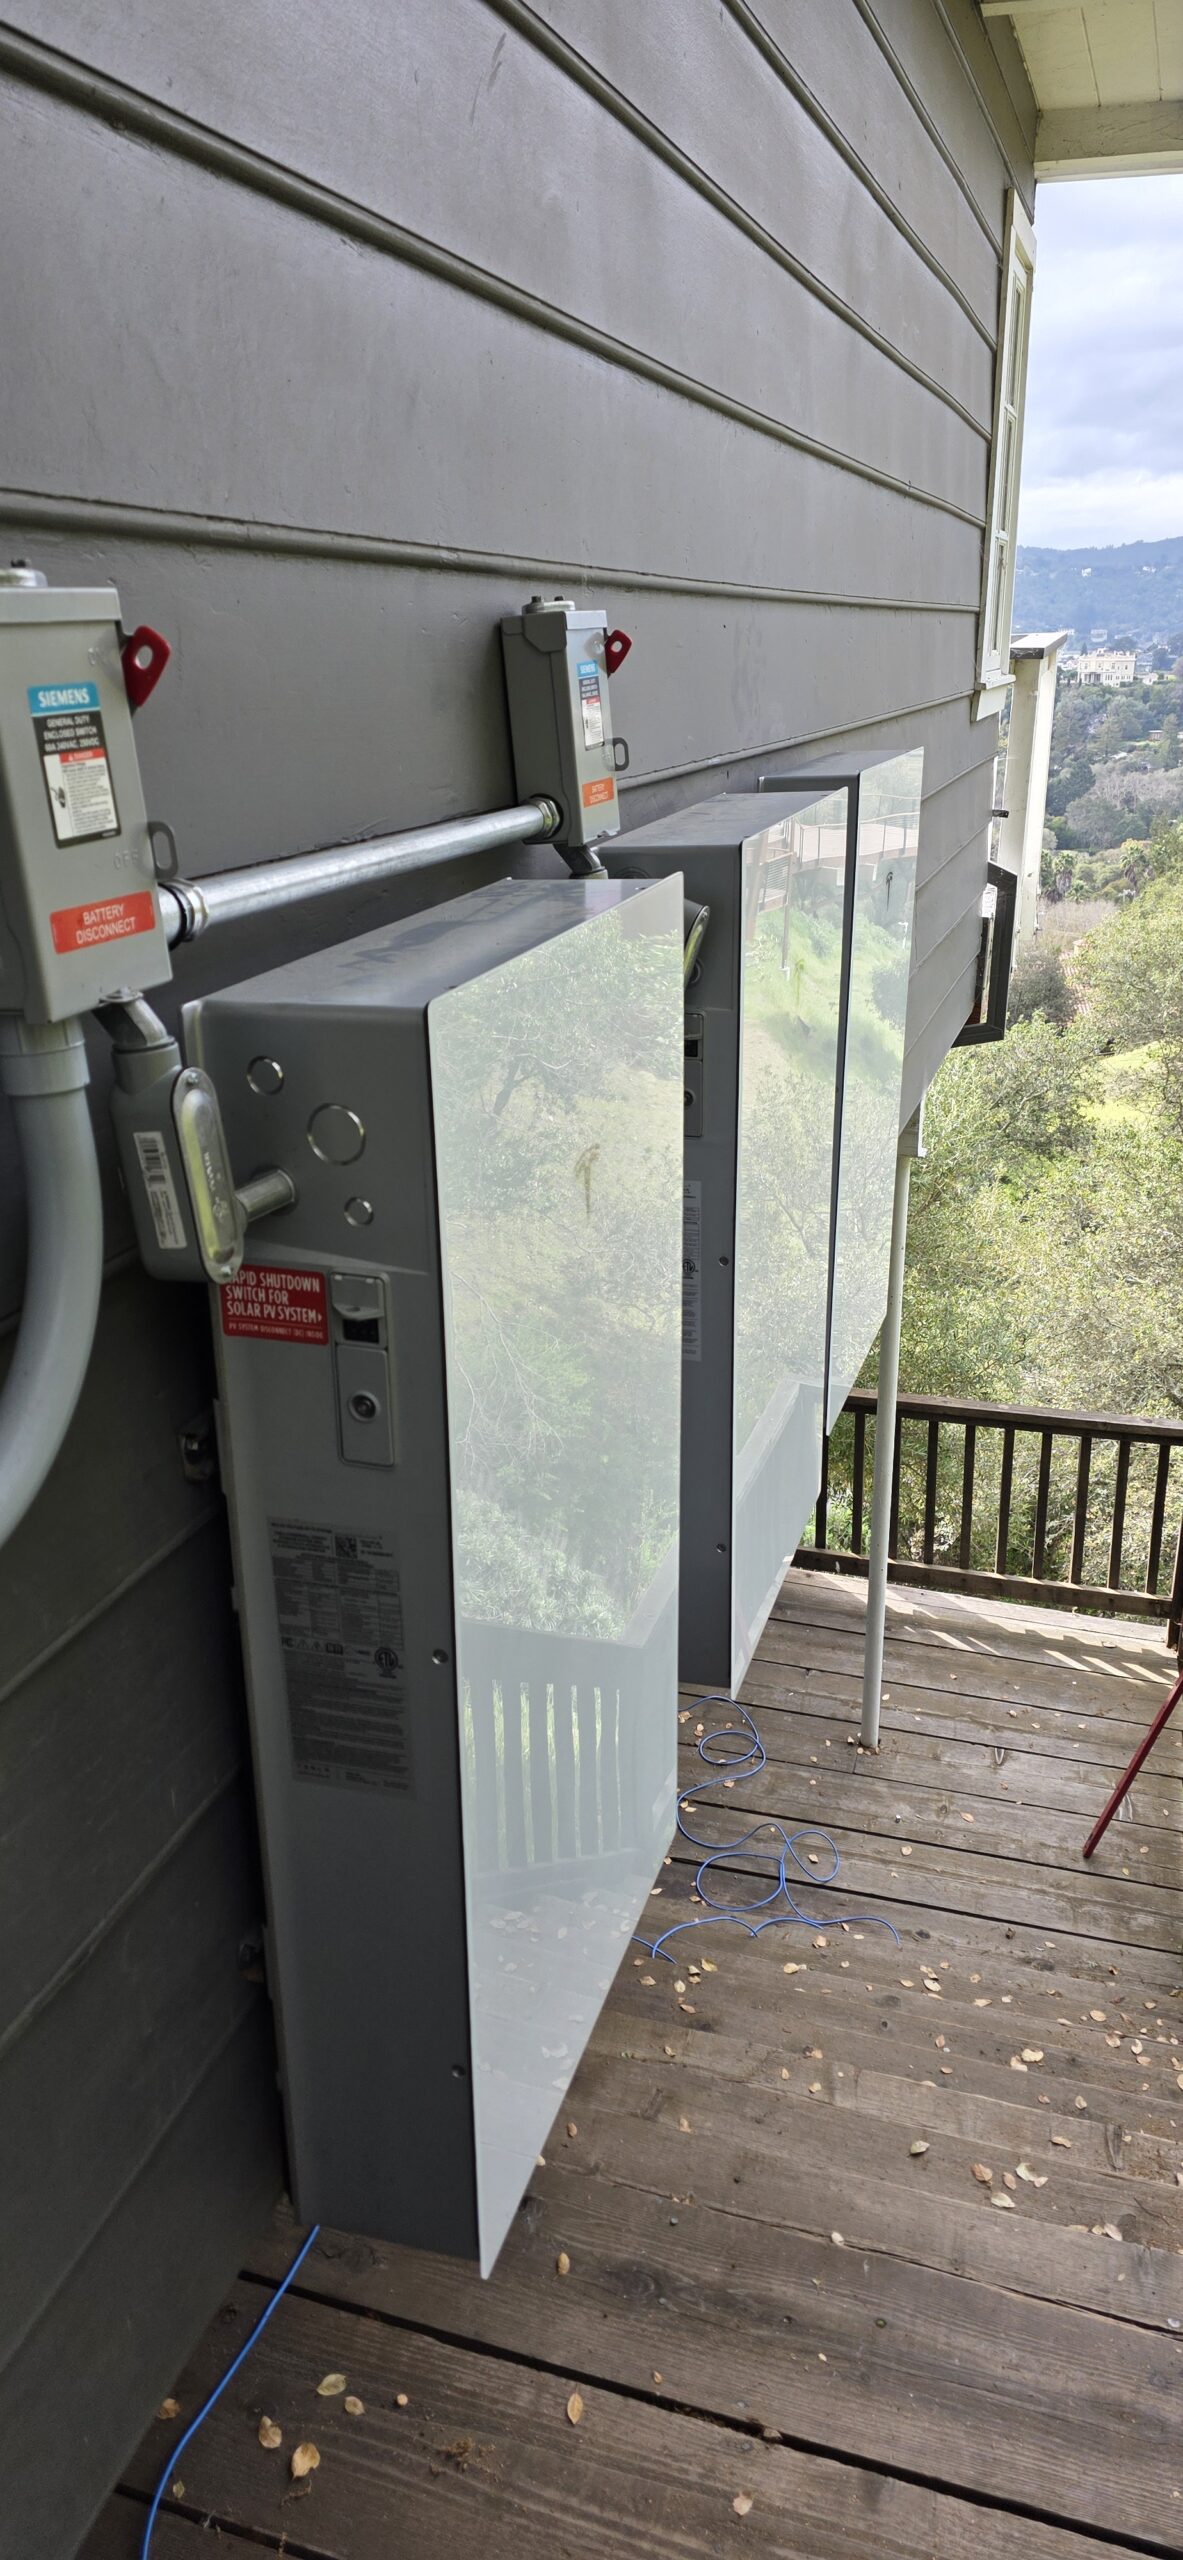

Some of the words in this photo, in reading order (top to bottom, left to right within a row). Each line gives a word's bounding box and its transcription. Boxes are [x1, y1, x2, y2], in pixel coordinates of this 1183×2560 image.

[38, 688, 90, 708] SIEMENS
[82, 903, 124, 925] BATTERY
[76, 916, 136, 944] DISCONNECT
[231, 1270, 257, 1286] APID
[259, 1272, 320, 1293] SHUTDOWN
[225, 1285, 266, 1302] SWITCH
[268, 1289, 289, 1305] FOR
[226, 1300, 261, 1318] SOLAR
[263, 1304, 276, 1319] PV
[277, 1305, 317, 1324] SYSTEM
